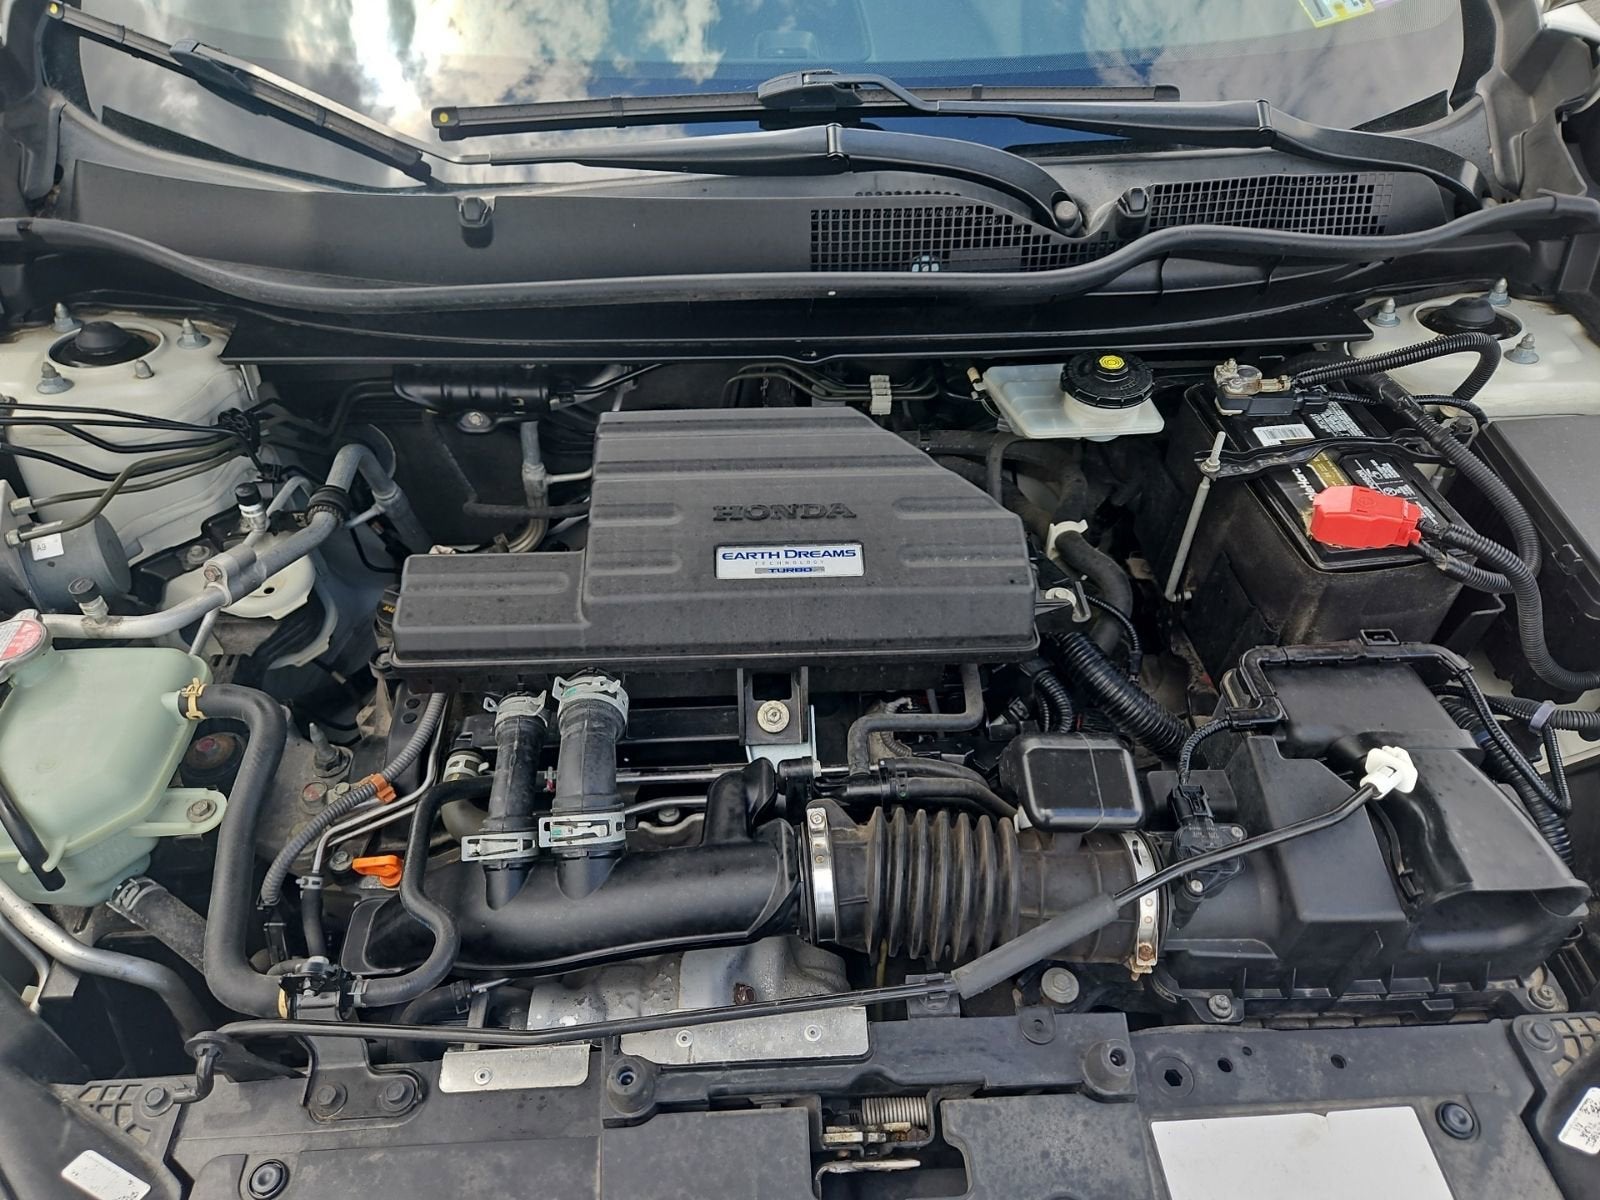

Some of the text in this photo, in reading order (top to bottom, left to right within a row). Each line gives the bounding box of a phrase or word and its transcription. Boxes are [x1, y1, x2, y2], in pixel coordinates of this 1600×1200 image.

[713, 503, 857, 521] HONDA
[722, 549, 857, 560] EARTH DREAMS
